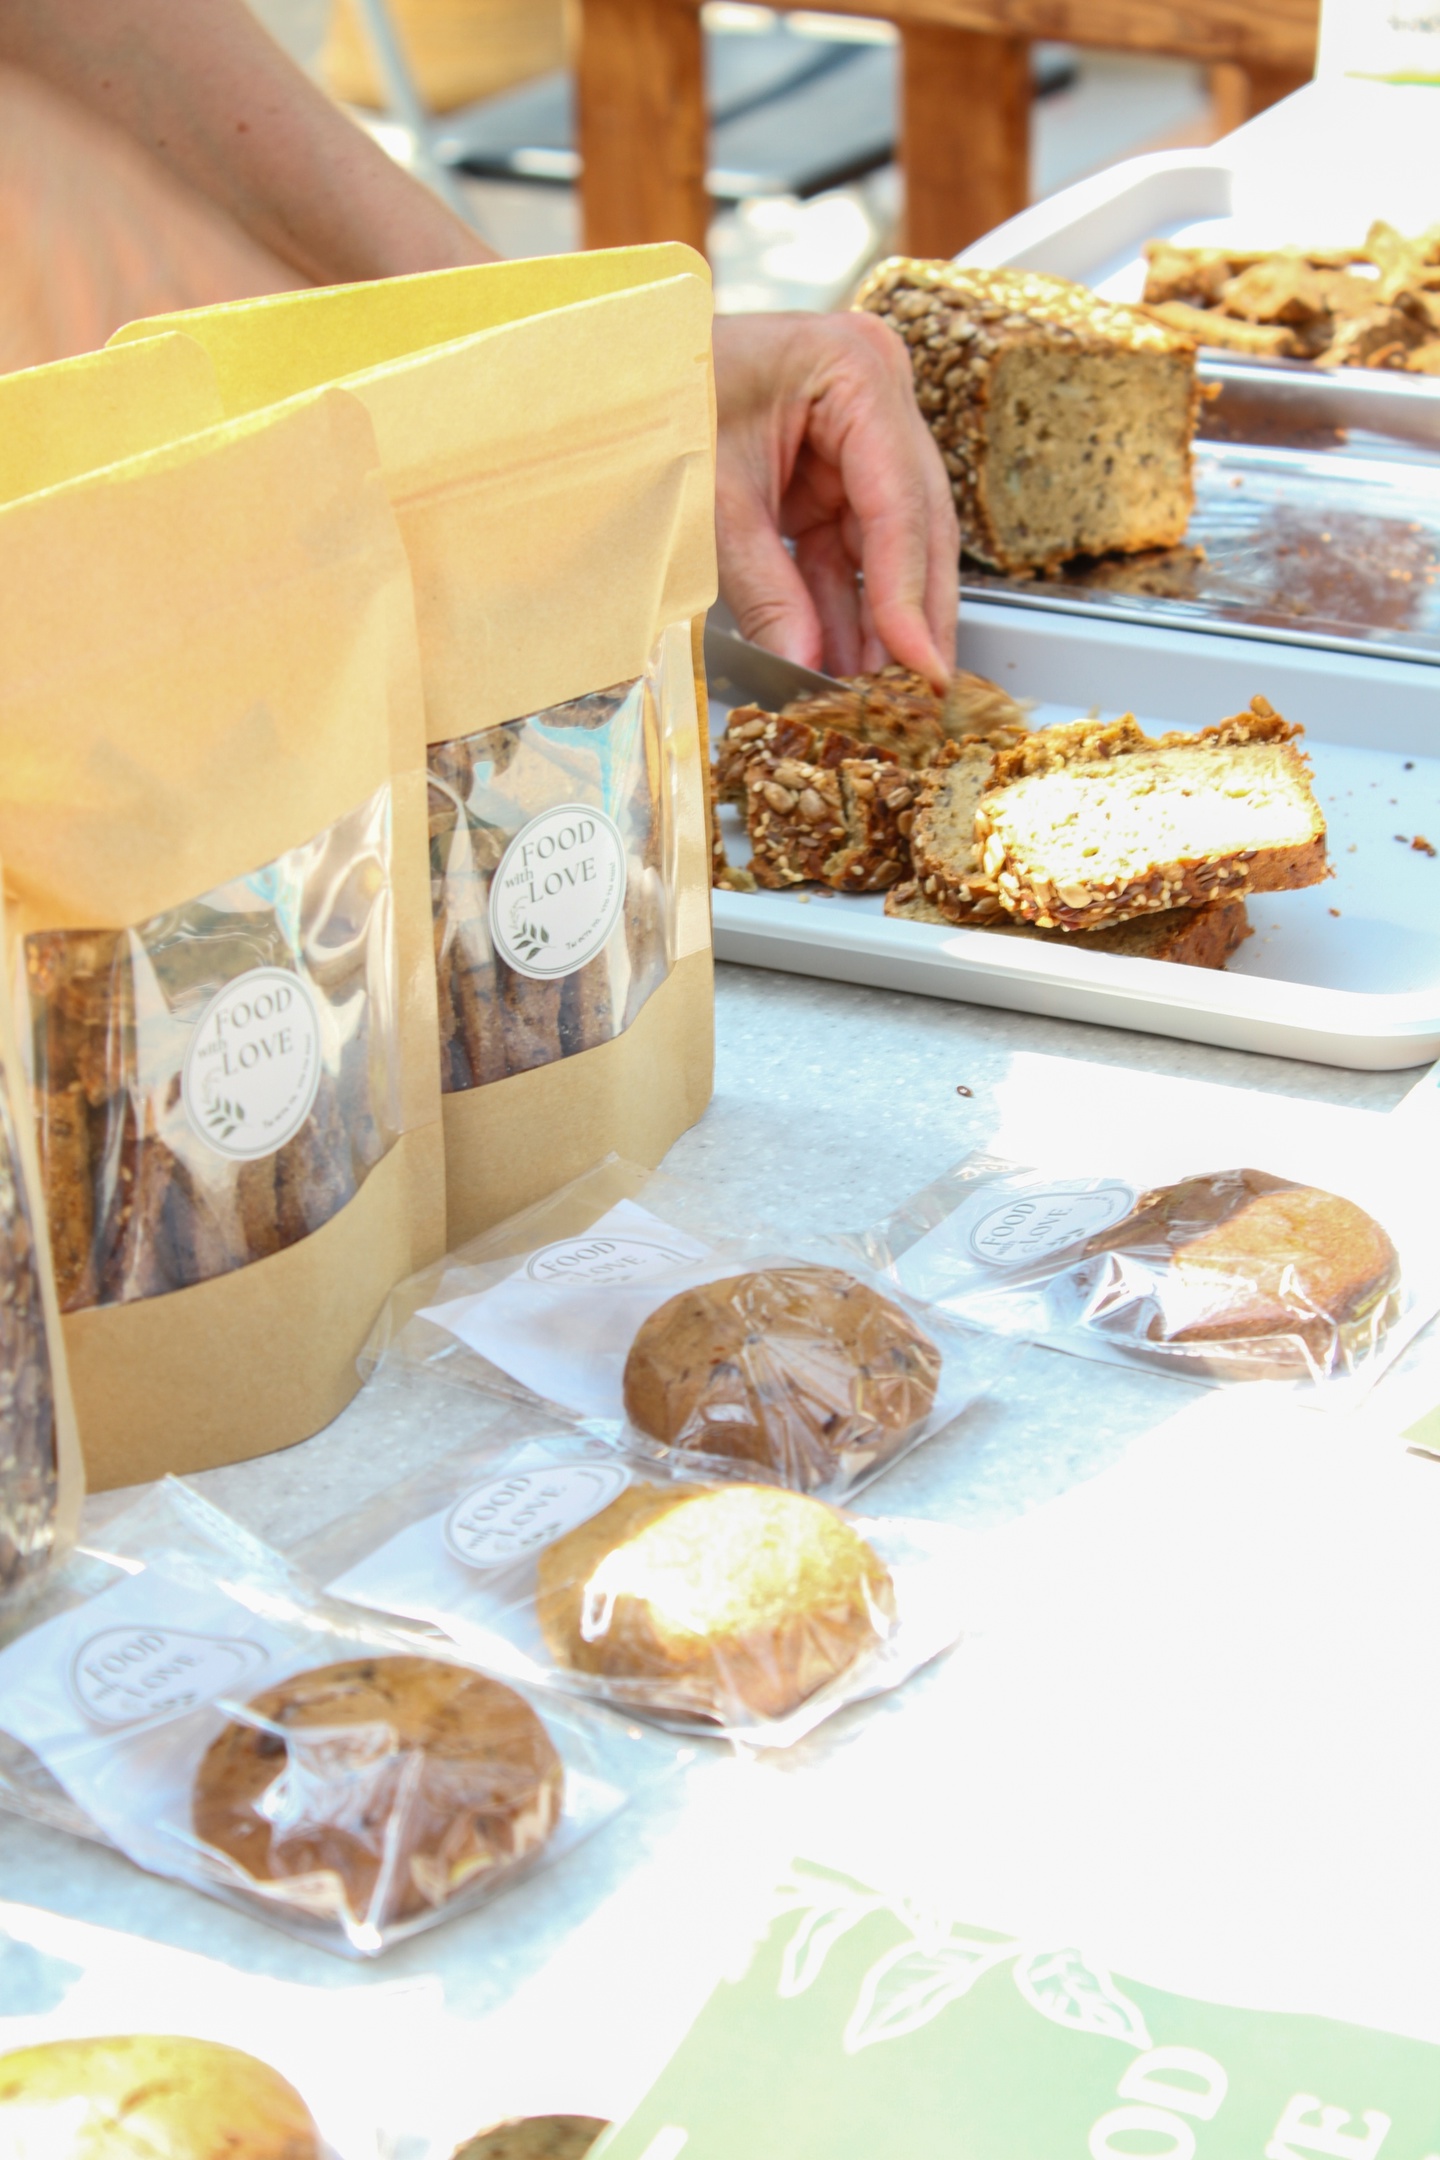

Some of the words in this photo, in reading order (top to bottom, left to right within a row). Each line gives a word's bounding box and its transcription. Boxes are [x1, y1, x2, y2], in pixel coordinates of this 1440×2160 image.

[522, 820, 596, 867] FOOD
[504, 868, 535, 889] with
[528, 857, 597, 904] LOVE
[216, 986, 292, 1036] FOOD
[222, 1027, 294, 1076] LOVE
[981, 1203, 1036, 1246] FOOD
[1019, 1207, 1073, 1245] LOVE
[540, 1242, 617, 1272] FOOD
[568, 1255, 647, 1278] LOVE
[457, 1477, 531, 1534] FOOD
[494, 1485, 568, 1537] LOVE
[84, 1633, 165, 1687] FOOD
